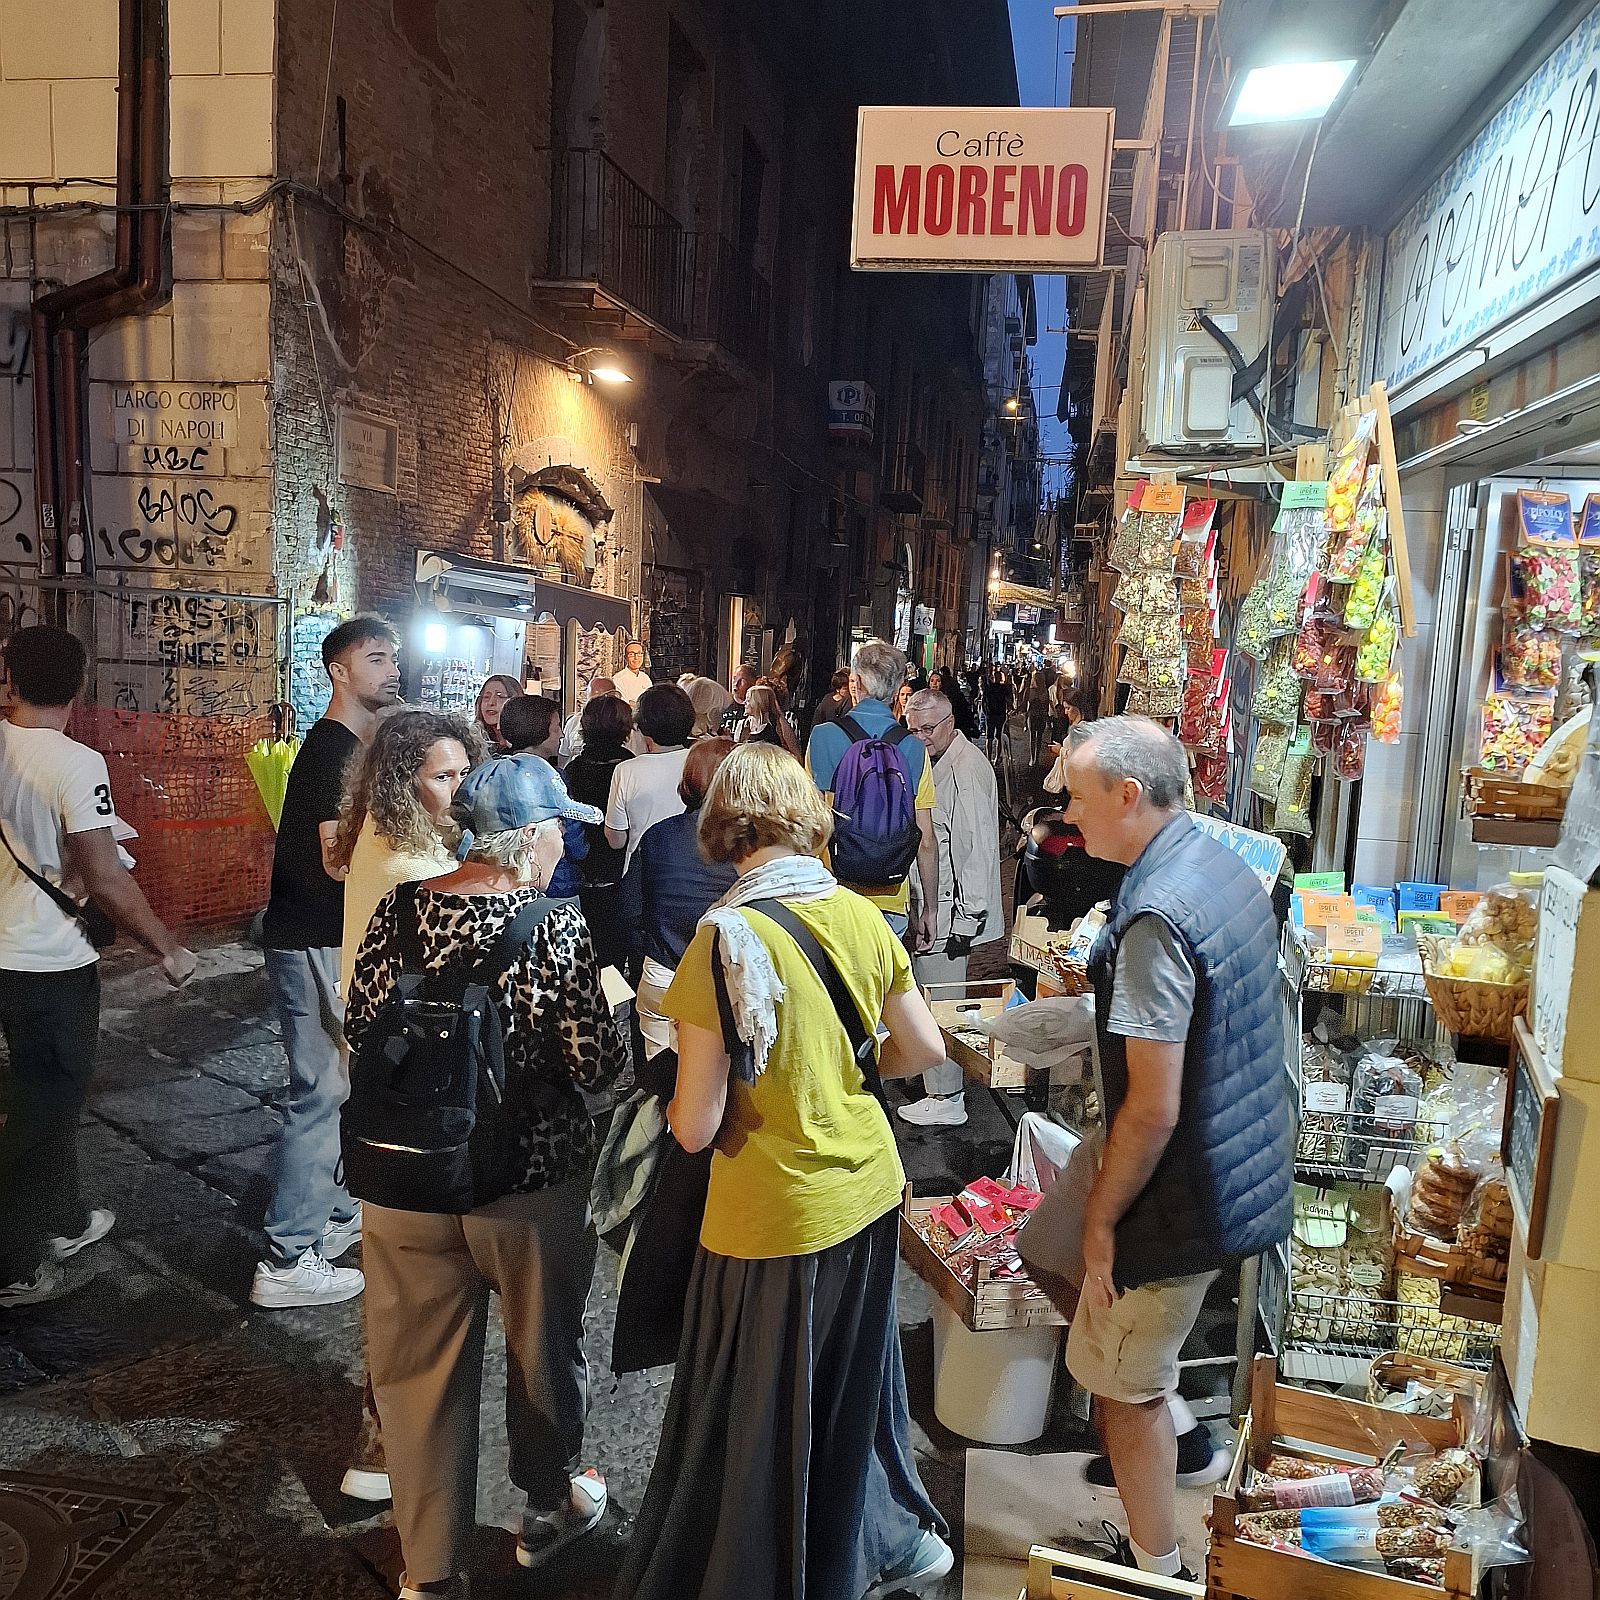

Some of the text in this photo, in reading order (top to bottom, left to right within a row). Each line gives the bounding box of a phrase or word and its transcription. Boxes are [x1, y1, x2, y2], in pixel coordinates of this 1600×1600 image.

[936, 130, 1024, 157] Caffè
[872, 163, 1088, 237] MORENO
[114, 389, 236, 411] LARGO CORPO
[127, 418, 224, 439] DI NAPOLI
[94, 783, 113, 816] 3
